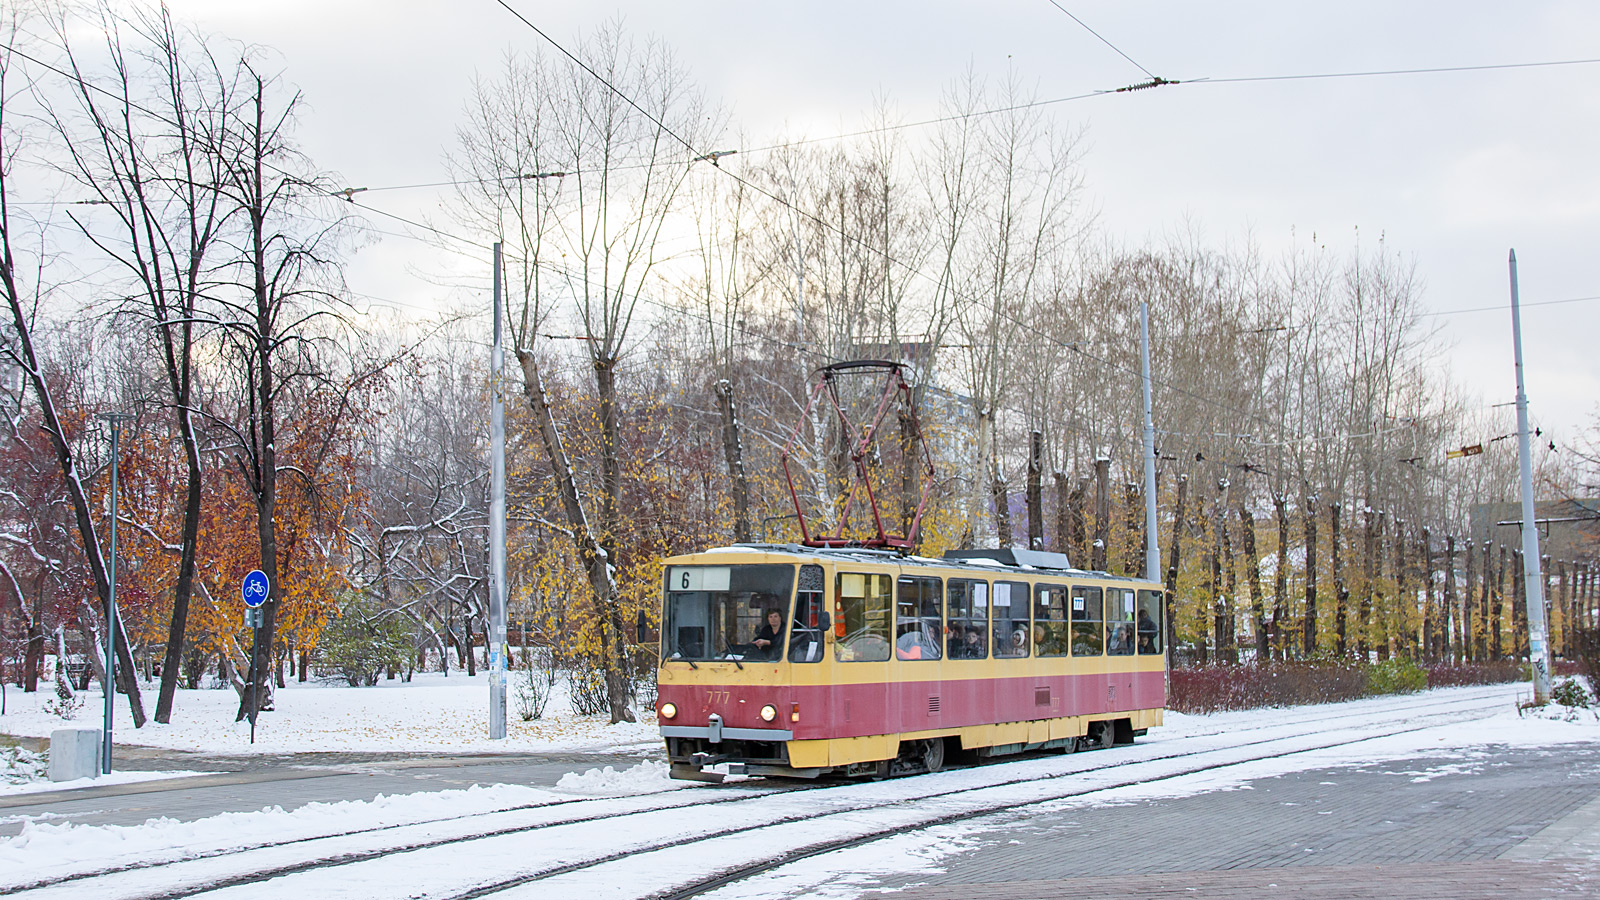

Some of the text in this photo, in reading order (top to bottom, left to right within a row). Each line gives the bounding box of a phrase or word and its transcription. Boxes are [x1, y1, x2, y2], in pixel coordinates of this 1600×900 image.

[681, 571, 690, 589] 6
[1074, 599, 1083, 608] 777
[706, 690, 730, 704] 777
[1051, 697, 1061, 707] 777
